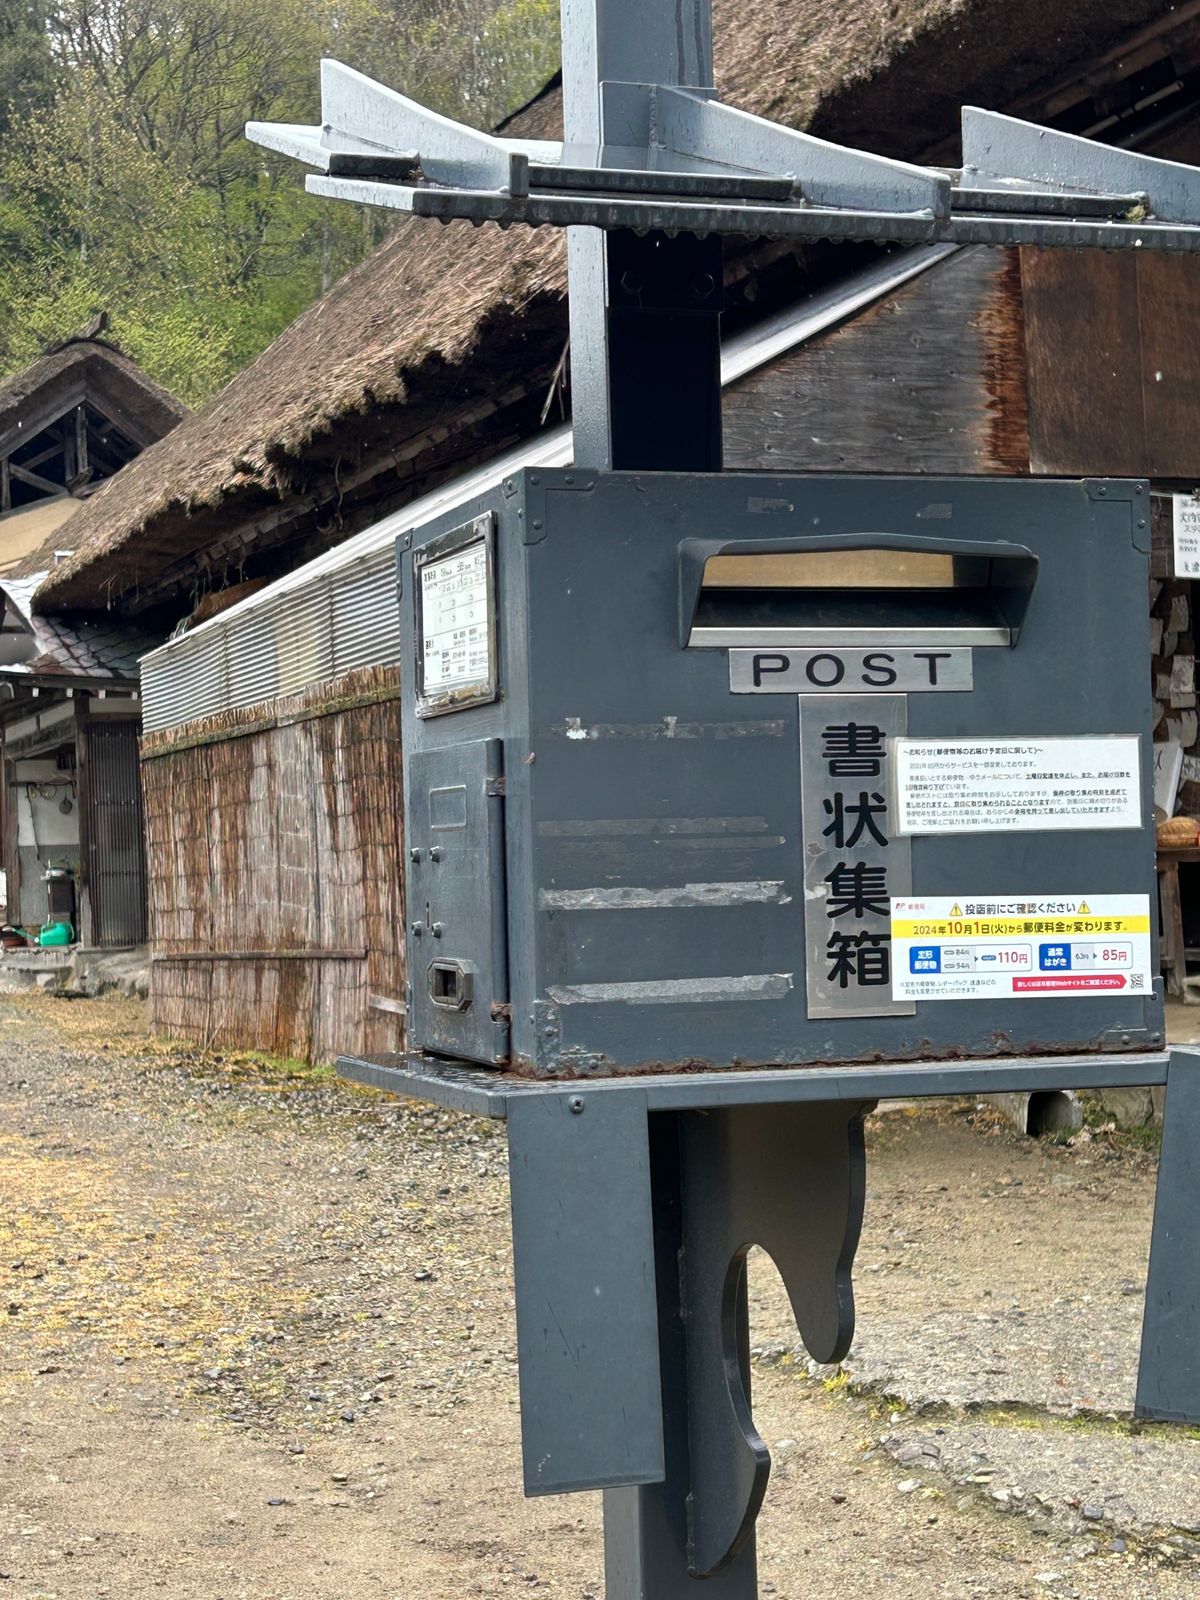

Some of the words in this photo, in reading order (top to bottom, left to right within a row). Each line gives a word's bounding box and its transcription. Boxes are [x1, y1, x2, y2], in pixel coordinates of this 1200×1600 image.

[752, 653, 952, 687] POST
[821, 722, 890, 988] 書状集箱
[965, 902, 1076, 915] 投函前にご確認ください
[913, 920, 1127, 935] 2024年10月1日(火)から郵便料金が変わります。
[998, 951, 1028, 964] 110円
[1047, 947, 1064, 957] 通常
[1102, 949, 1127, 962] 85円
[1044, 957, 1067, 967] はがき
